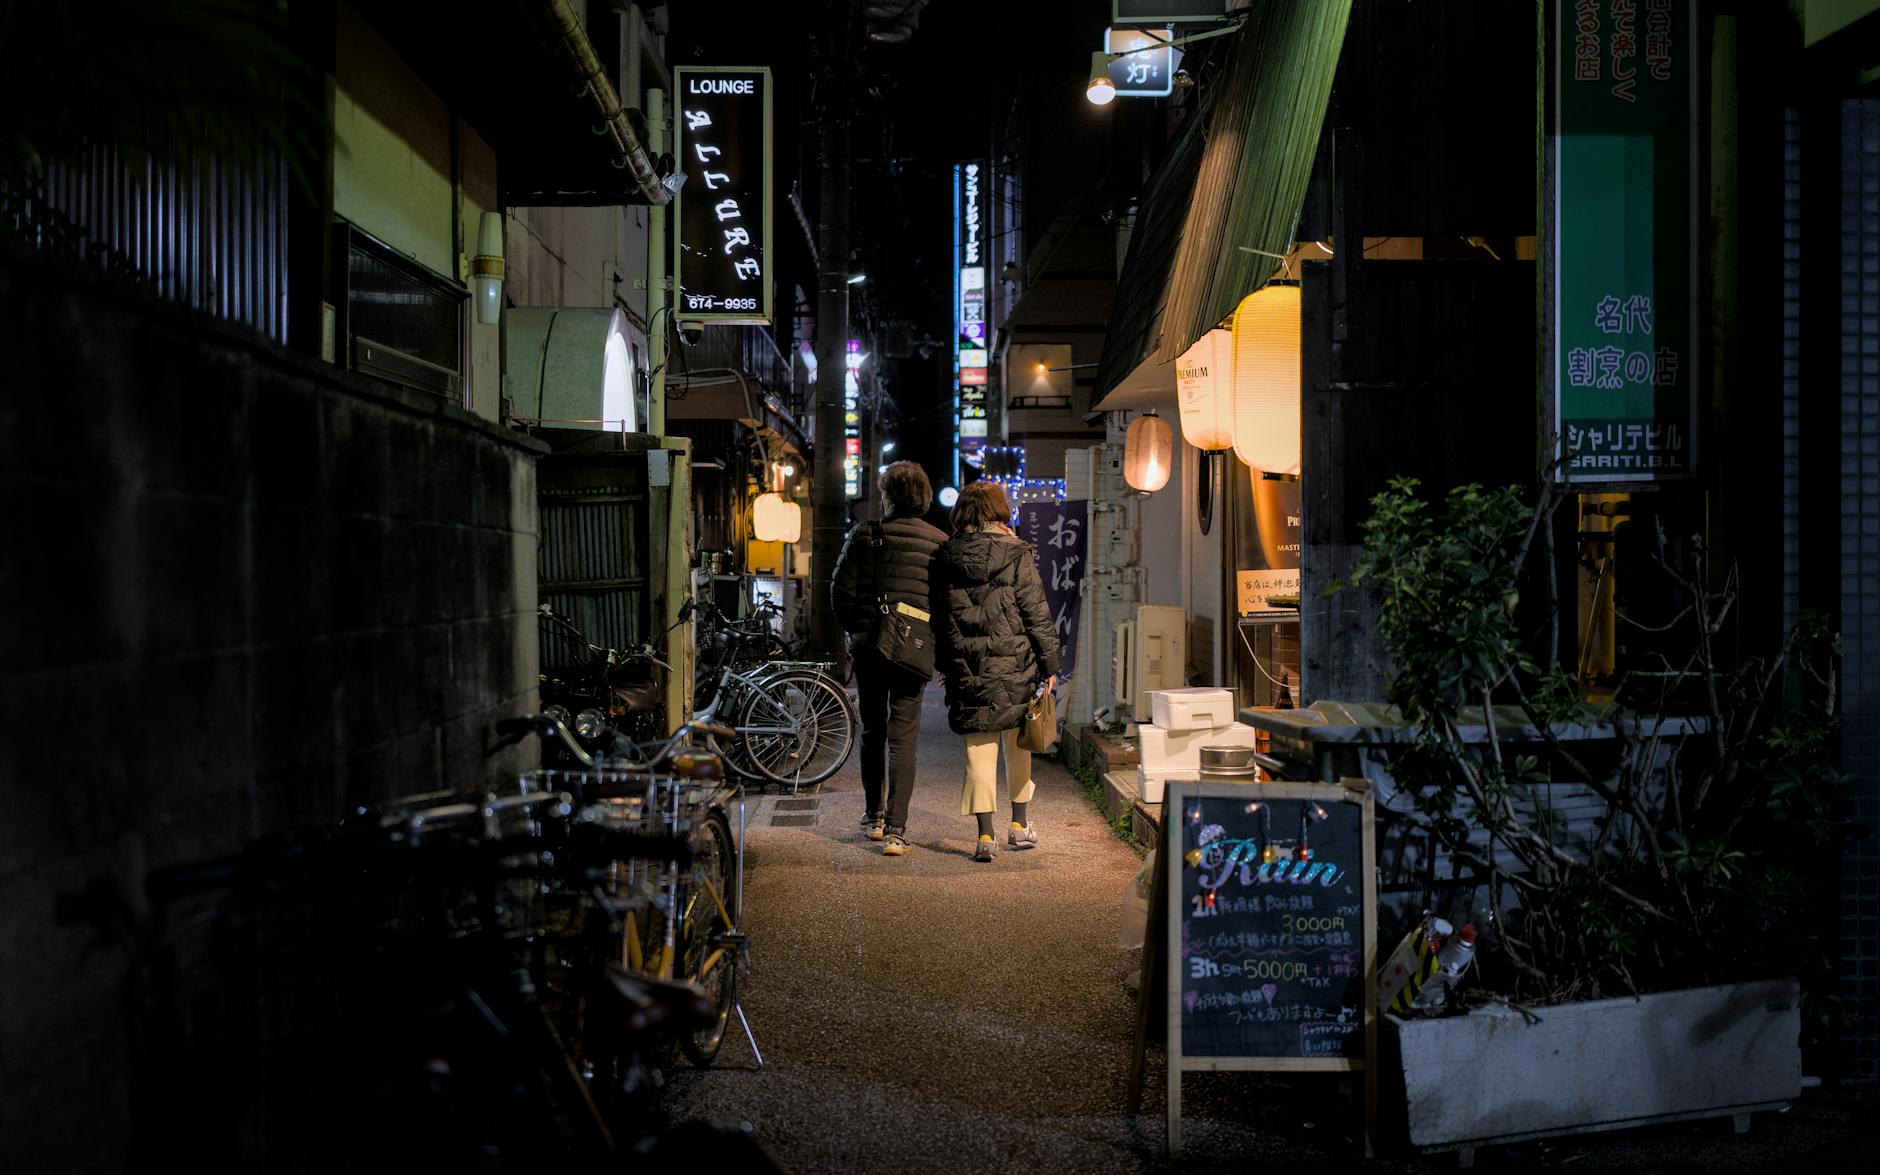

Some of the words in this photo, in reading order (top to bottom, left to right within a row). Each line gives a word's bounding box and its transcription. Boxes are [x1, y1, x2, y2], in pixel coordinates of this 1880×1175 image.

[690, 79, 754, 94] LOUNGE
[685, 110, 761, 281] ALLURE
[689, 298, 757, 310] 674-9935
[1595, 295, 1652, 334] 名代
[1568, 345, 1679, 389] 割烹の店
[1568, 424, 1682, 451] シャリテビル
[1287, 516, 1300, 527] PR
[1047, 513, 1081, 657] おばん
[1282, 914, 1345, 935] 3000円
[1190, 957, 1220, 978] 3h
[1243, 959, 1308, 982] 5000円
